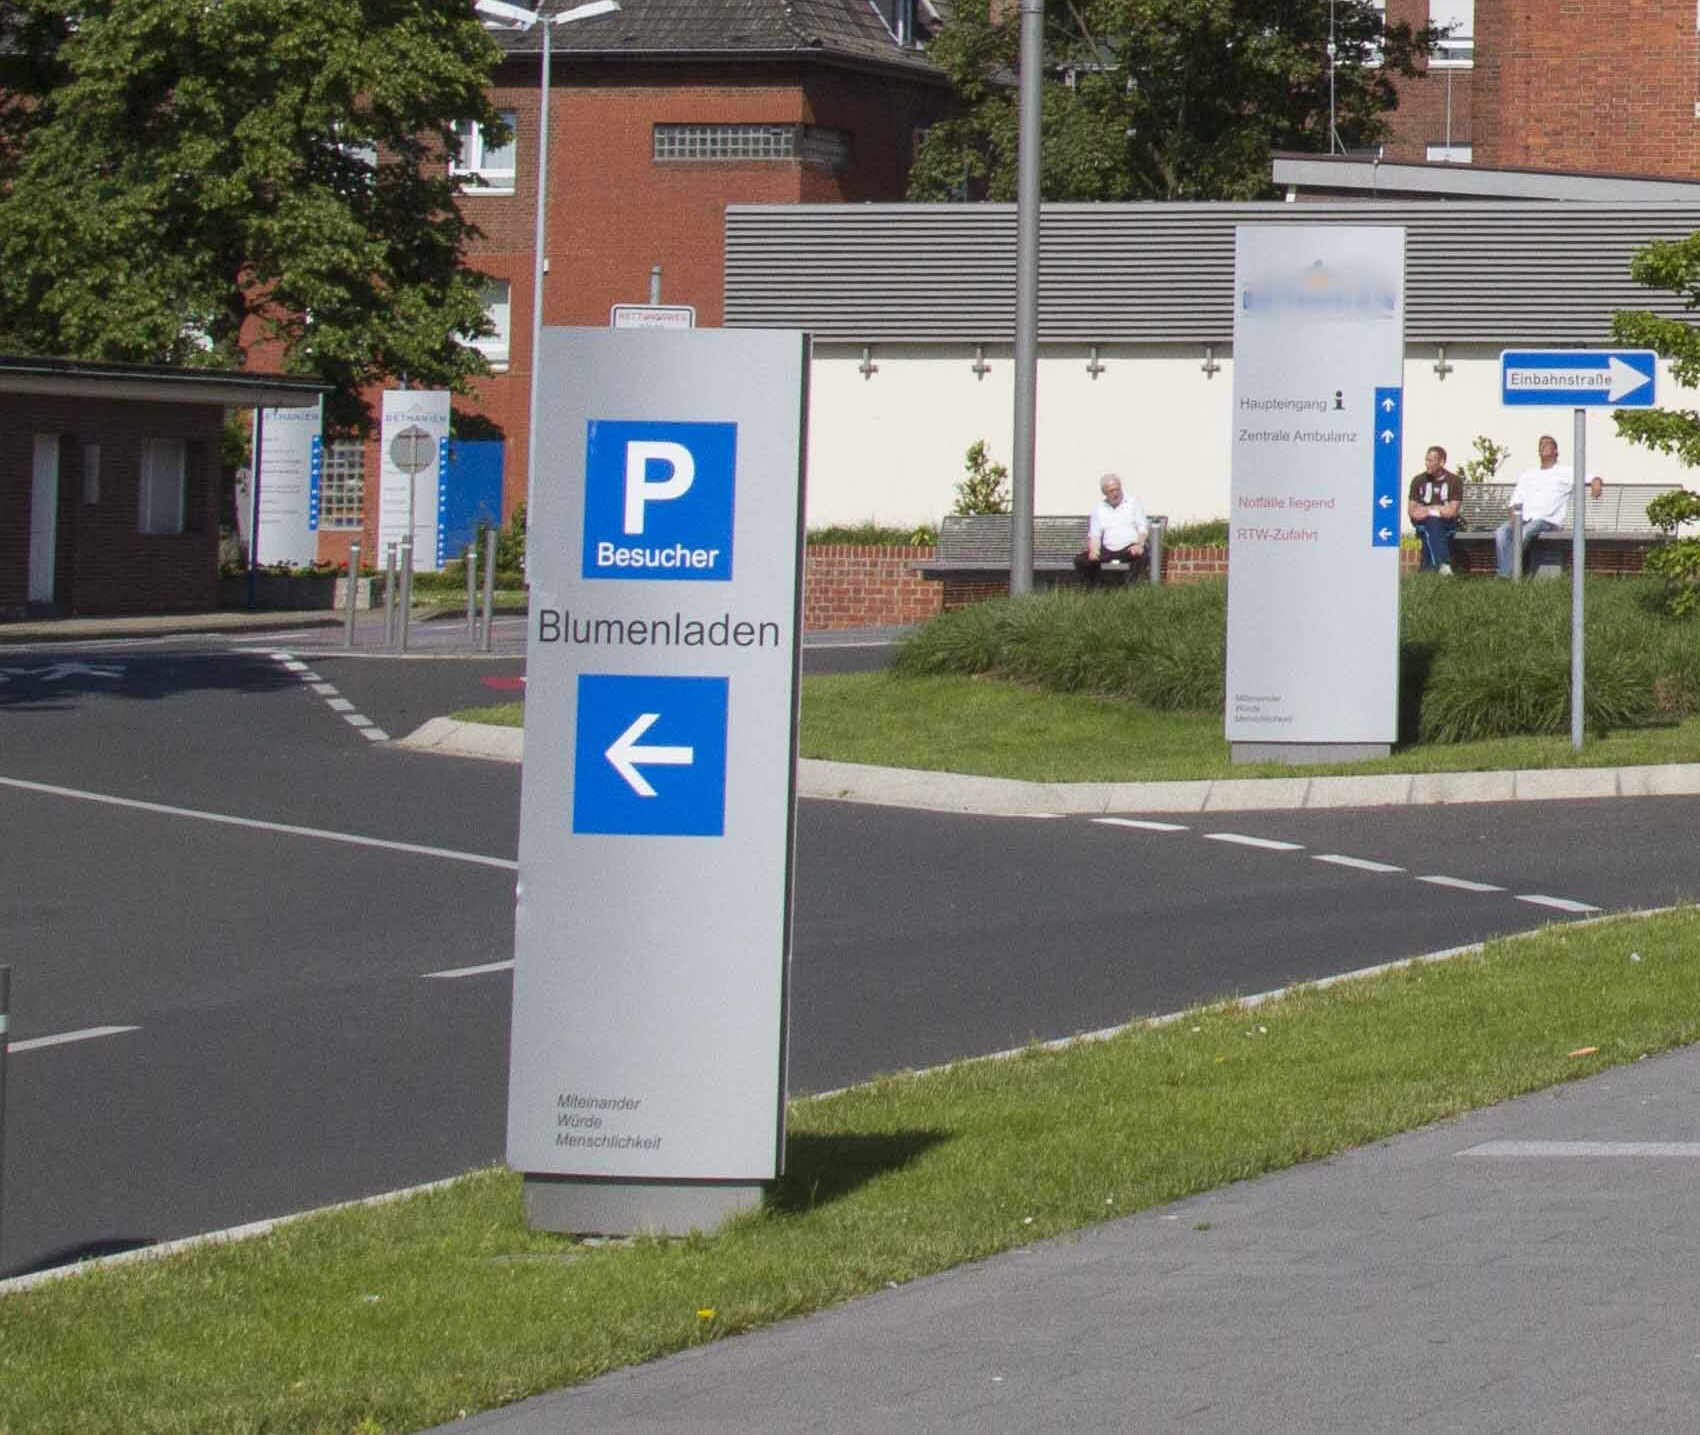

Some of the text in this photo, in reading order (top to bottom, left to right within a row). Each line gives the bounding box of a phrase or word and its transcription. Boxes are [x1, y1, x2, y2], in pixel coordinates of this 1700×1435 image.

[1510, 373, 1613, 386] Einbahnstraße
[1240, 398, 1327, 412] Haupteingang
[1238, 429, 1358, 443] Zentrale Ambulanz
[623, 440, 696, 535] P
[1288, 496, 1336, 512] liegend
[1237, 528, 1318, 542] RTW-Zufahrt
[597, 542, 719, 567] Besucher
[539, 609, 780, 647] Blumenladen
[557, 1093, 642, 1110] Miteinander
[558, 1113, 602, 1127] Würde
[555, 1133, 662, 1150] Menschlichkeit
